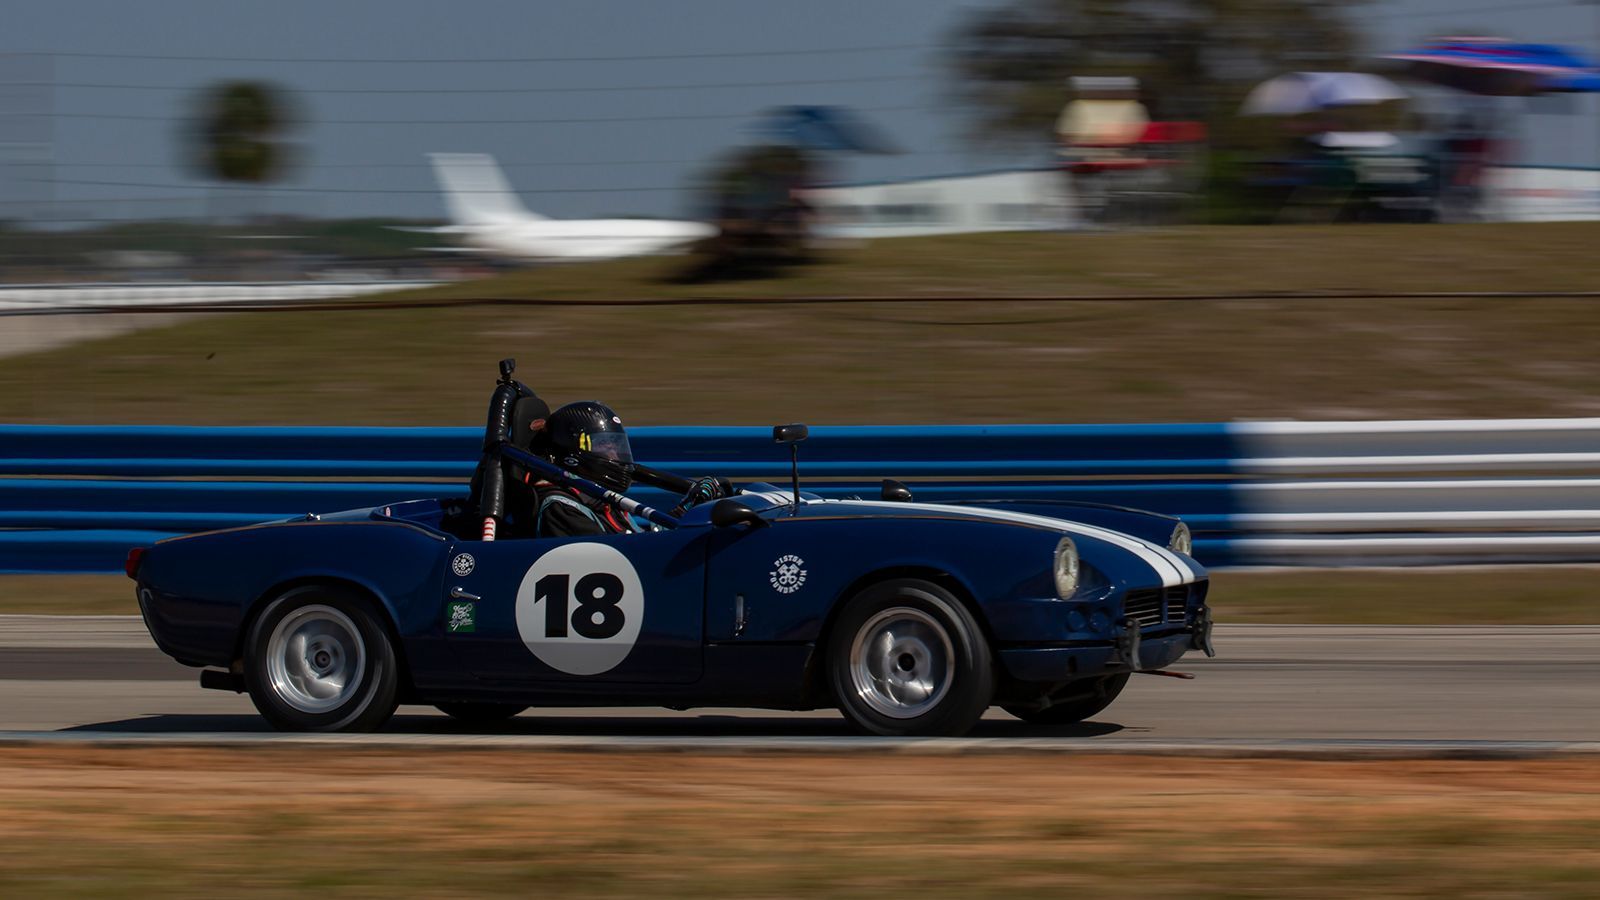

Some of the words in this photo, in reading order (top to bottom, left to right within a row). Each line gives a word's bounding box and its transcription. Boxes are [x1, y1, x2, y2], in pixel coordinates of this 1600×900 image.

[774, 555, 804, 567] PISTON
[769, 570, 807, 594] FOUNDATION
[535, 573, 625, 639] 18
